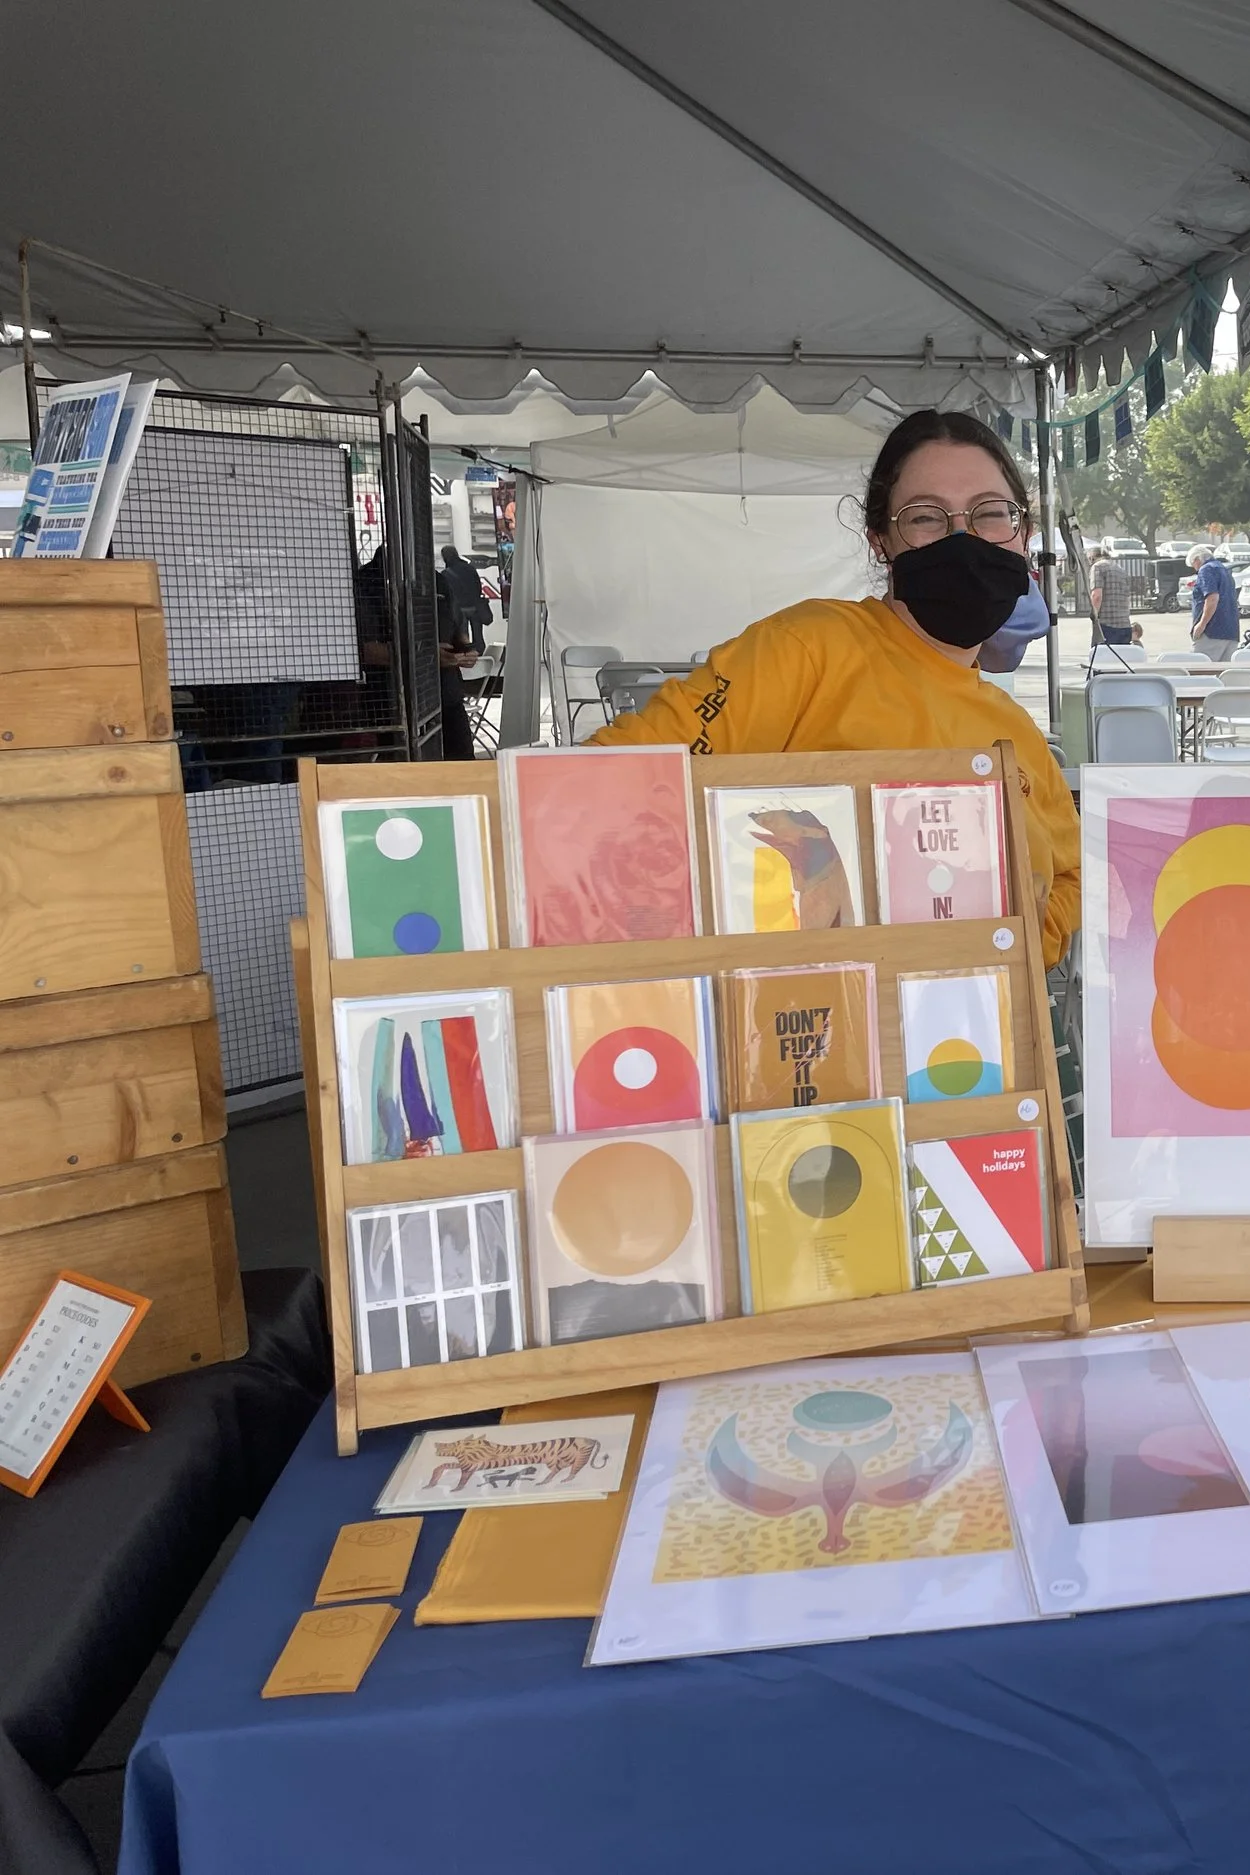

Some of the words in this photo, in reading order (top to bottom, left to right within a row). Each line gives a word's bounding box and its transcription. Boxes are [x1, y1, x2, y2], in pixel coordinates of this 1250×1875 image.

[920, 800, 952, 823] LET
[917, 829, 959, 852] LOVE
[933, 897, 953, 919] IN!
[775, 1008, 830, 1036] DON'T
[780, 1033, 829, 1061] FUCK
[794, 1061, 812, 1086] IT
[793, 1086, 817, 1107] UP
[993, 1148, 1026, 1159] happy
[982, 1160, 1026, 1173] holidays
